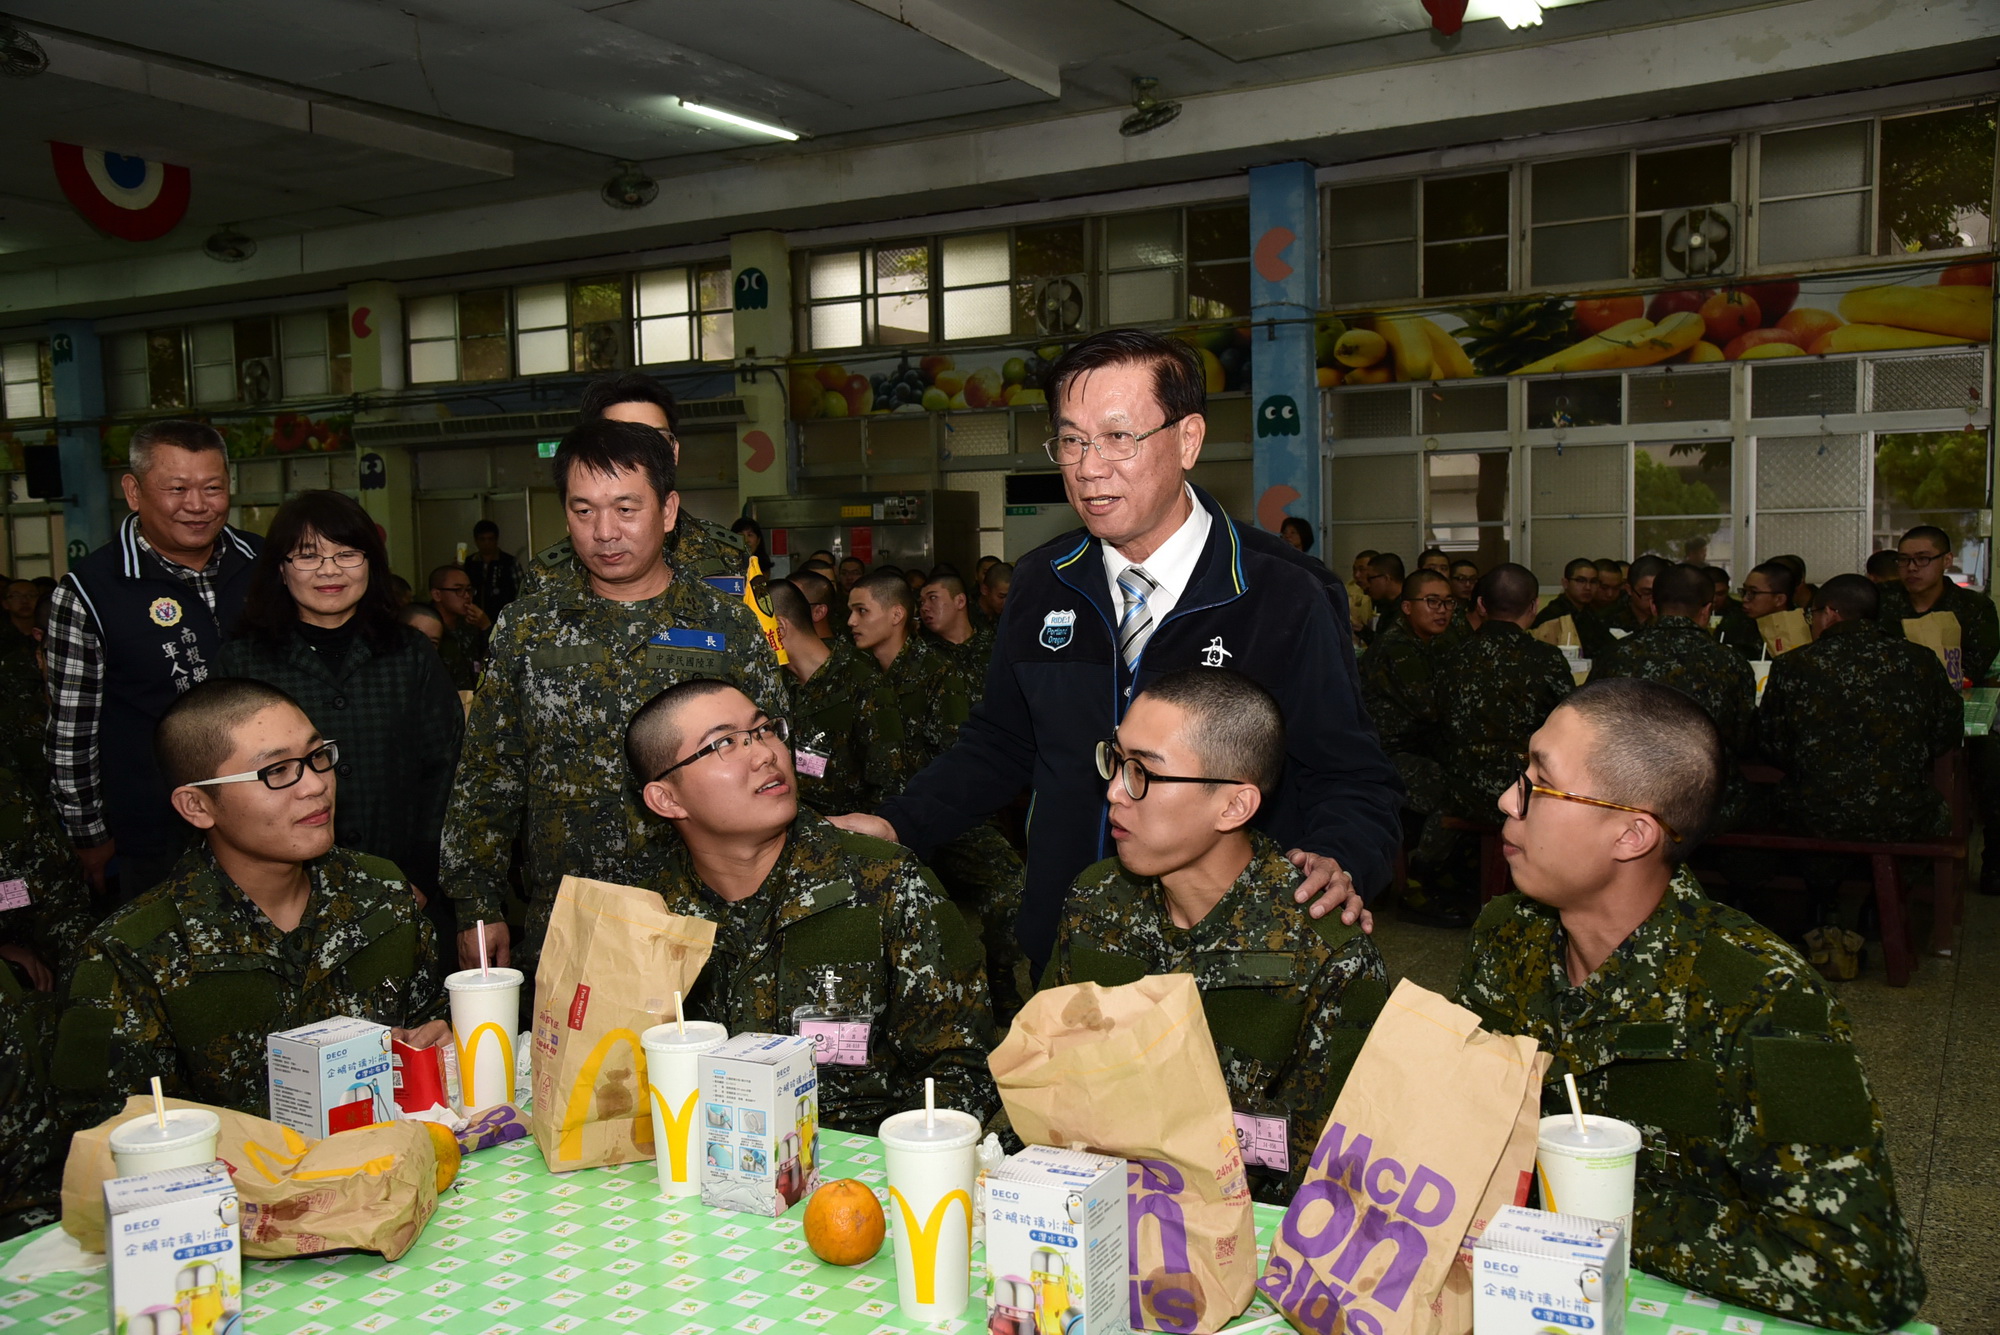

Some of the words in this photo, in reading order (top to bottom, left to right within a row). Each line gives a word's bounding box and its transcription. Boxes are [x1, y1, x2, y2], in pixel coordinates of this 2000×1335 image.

[180, 627, 208, 683] 南投縣
[655, 652, 715, 668] 中華民國陸軍
[326, 1048, 348, 1060] DECO
[326, 1053, 388, 1078] 企鵝玻璃水瓶
[776, 1066, 791, 1078] DECO
[1308, 1121, 1456, 1228] McD
[992, 1188, 1020, 1200] DECO
[124, 1219, 160, 1232] DECO
[992, 1208, 1075, 1234] 企鵝玻璃水瓶
[124, 1228, 229, 1257] 企鵝玻璃水瓶
[1483, 1260, 1519, 1274] DECO
[1483, 1283, 1591, 1314] 企鵝玻璃水瓶
